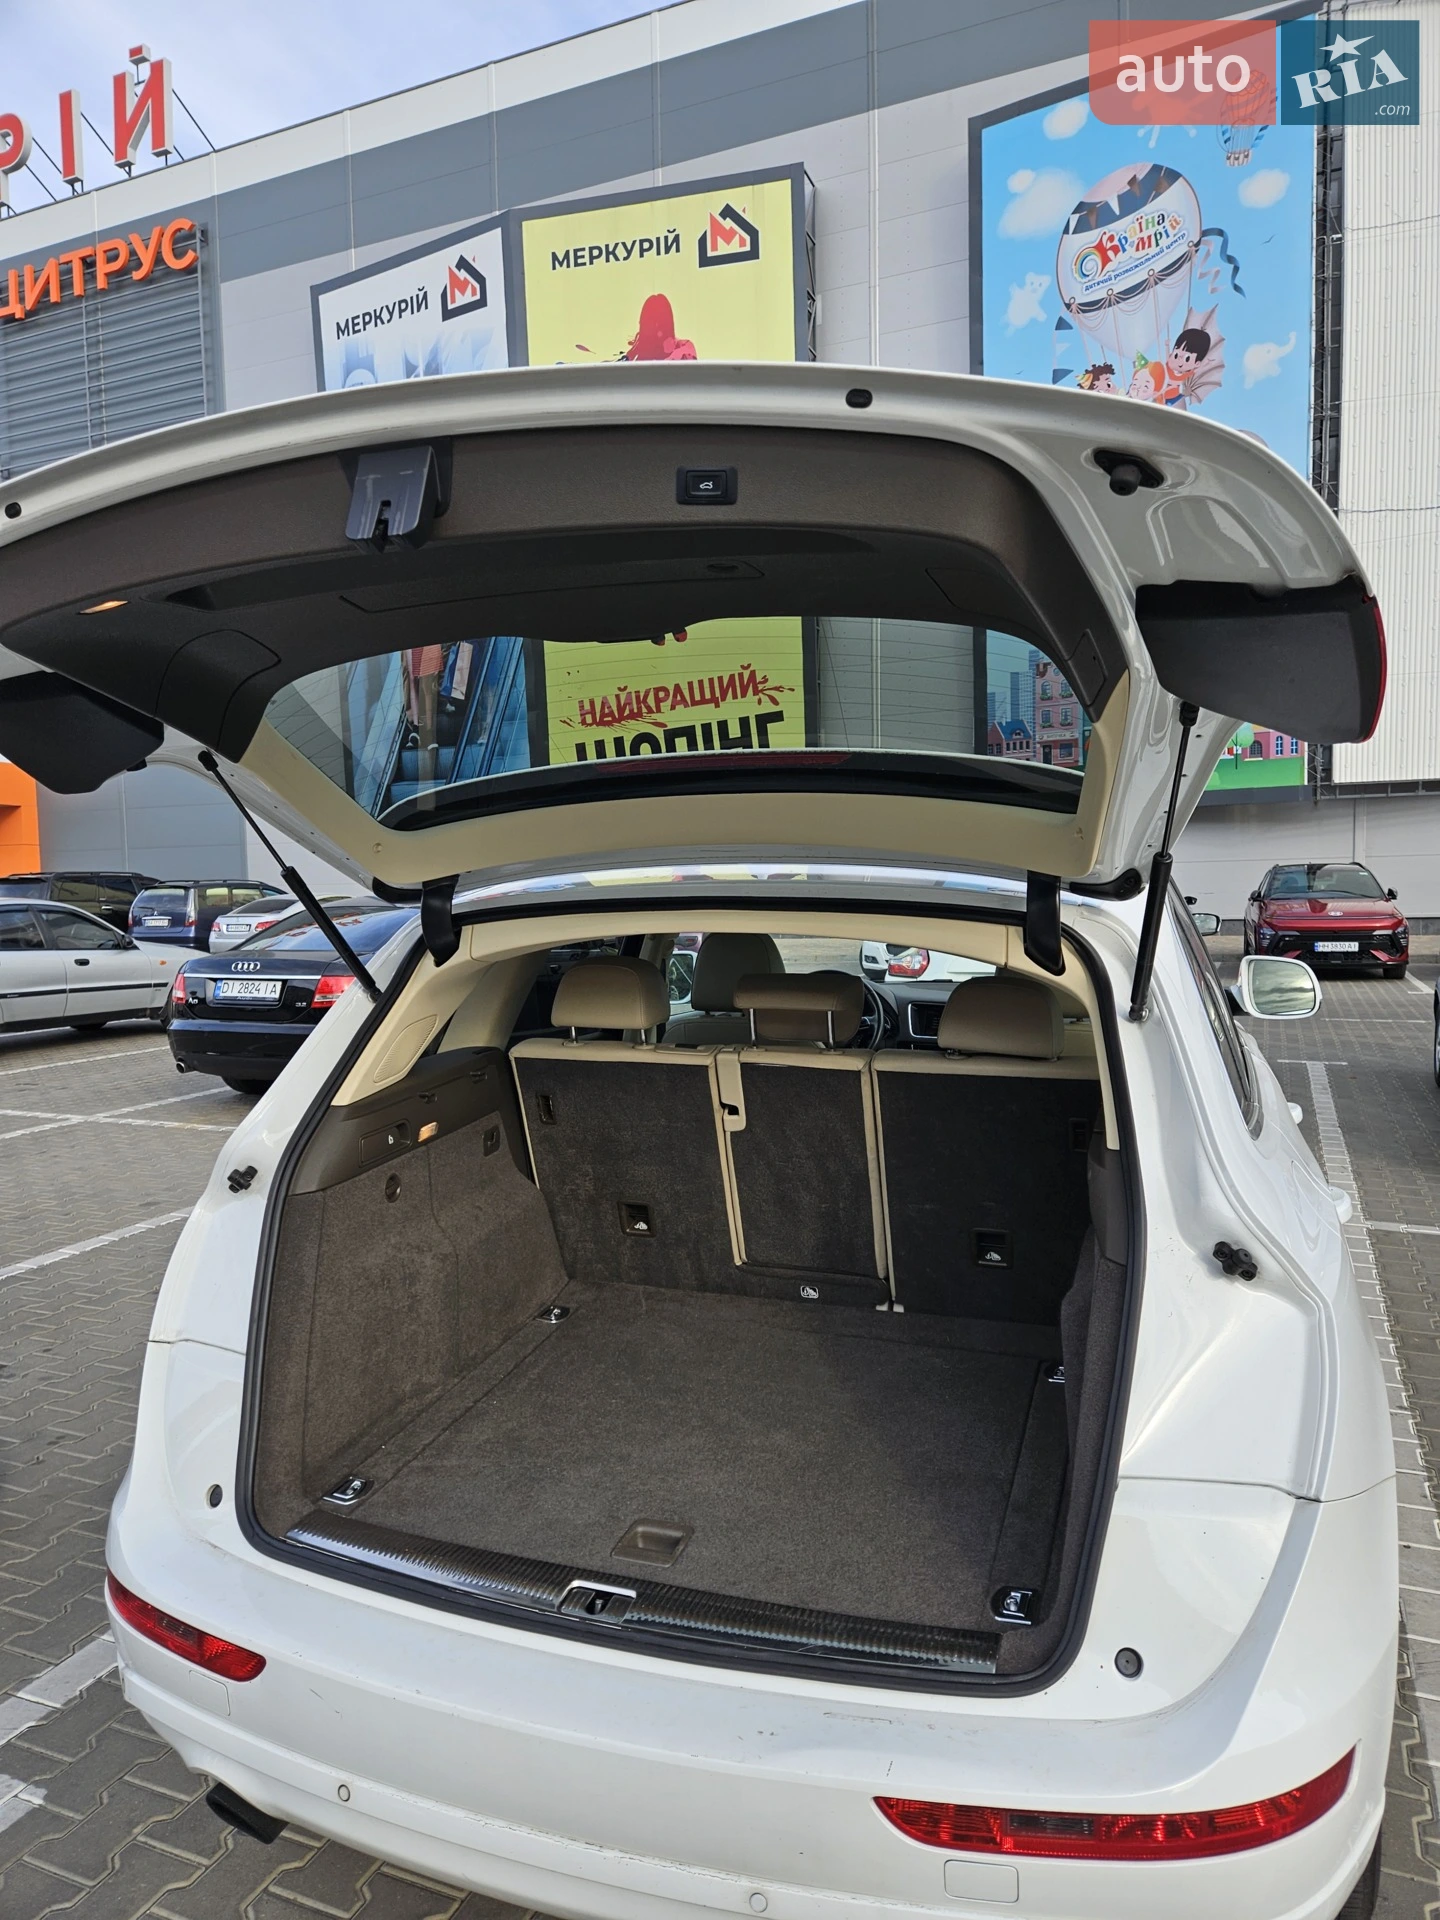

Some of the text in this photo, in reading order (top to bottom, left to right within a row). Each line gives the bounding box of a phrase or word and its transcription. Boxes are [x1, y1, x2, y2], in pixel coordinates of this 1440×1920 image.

[0, 217, 199, 320] ЦИТРУС
[551, 228, 681, 271] МЕРКУРІЙ
[1073, 212, 1166, 279] Країна
[1084, 232, 1187, 292] дитячий розважальний центр
[335, 285, 429, 340] МЕРКУРІЙ
[578, 663, 760, 728] НАЙКРАЩИЙ
[237, 982, 262, 995] 2824
